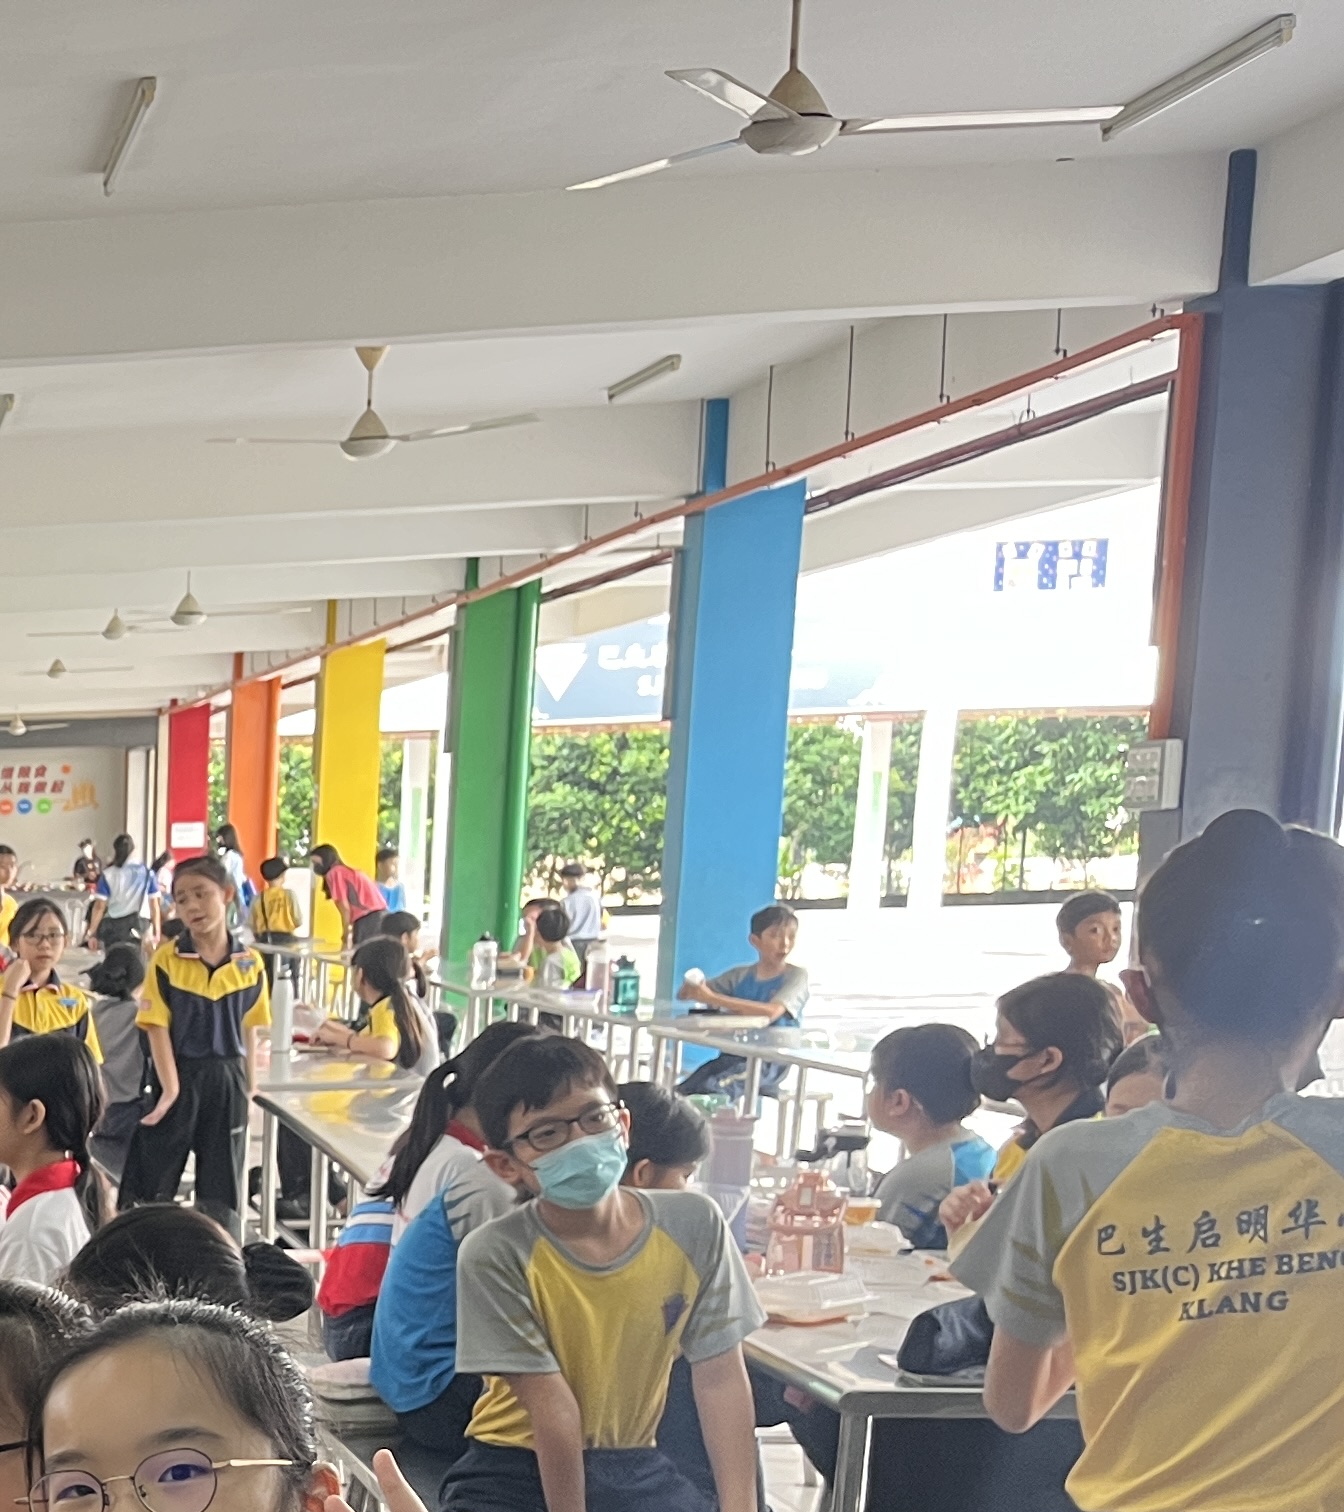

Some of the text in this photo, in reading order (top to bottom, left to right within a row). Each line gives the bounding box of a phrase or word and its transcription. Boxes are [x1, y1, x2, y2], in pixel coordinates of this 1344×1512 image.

[1097, 1198, 1344, 1256] 巴生启明华
[1112, 1248, 1344, 1296] SJK(C) KHE BEN
[1178, 1289, 1290, 1322] KLANG
